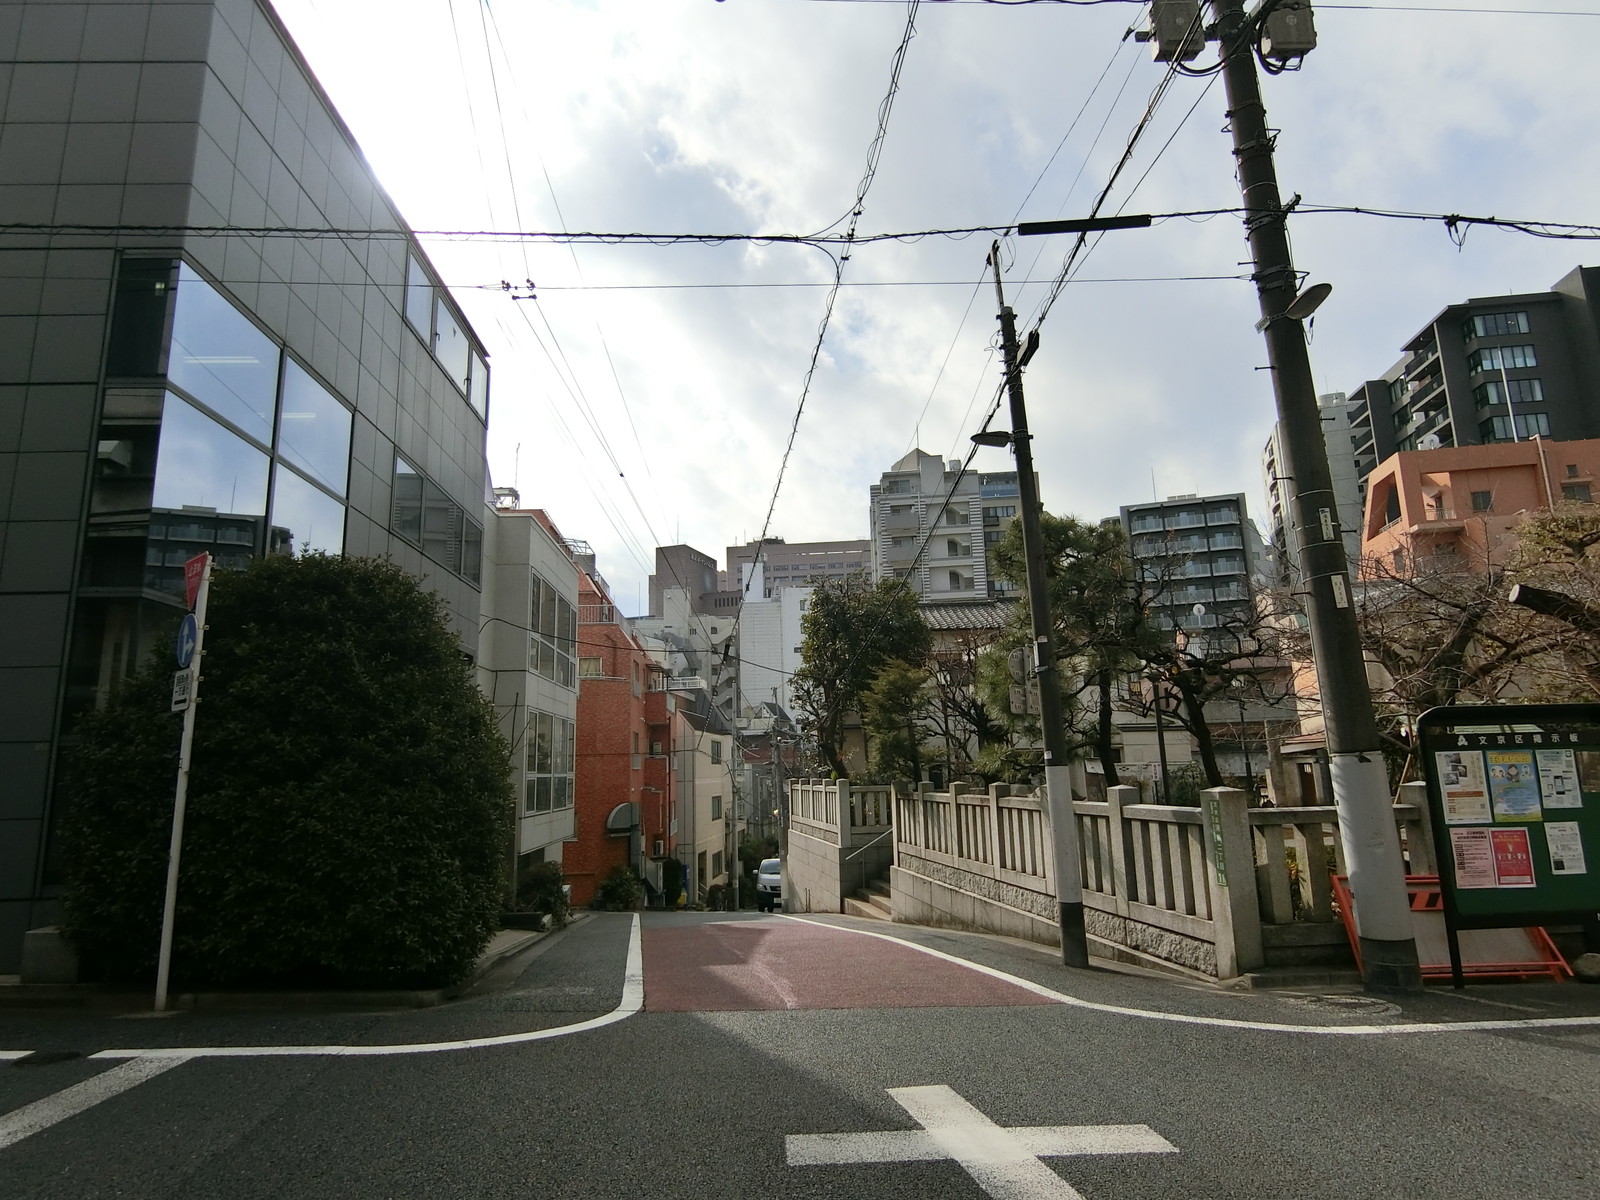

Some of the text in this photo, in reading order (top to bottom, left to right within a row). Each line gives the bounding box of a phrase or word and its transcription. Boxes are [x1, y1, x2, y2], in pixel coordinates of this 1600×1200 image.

[1478, 733, 1578, 745] 文京区掲示板
